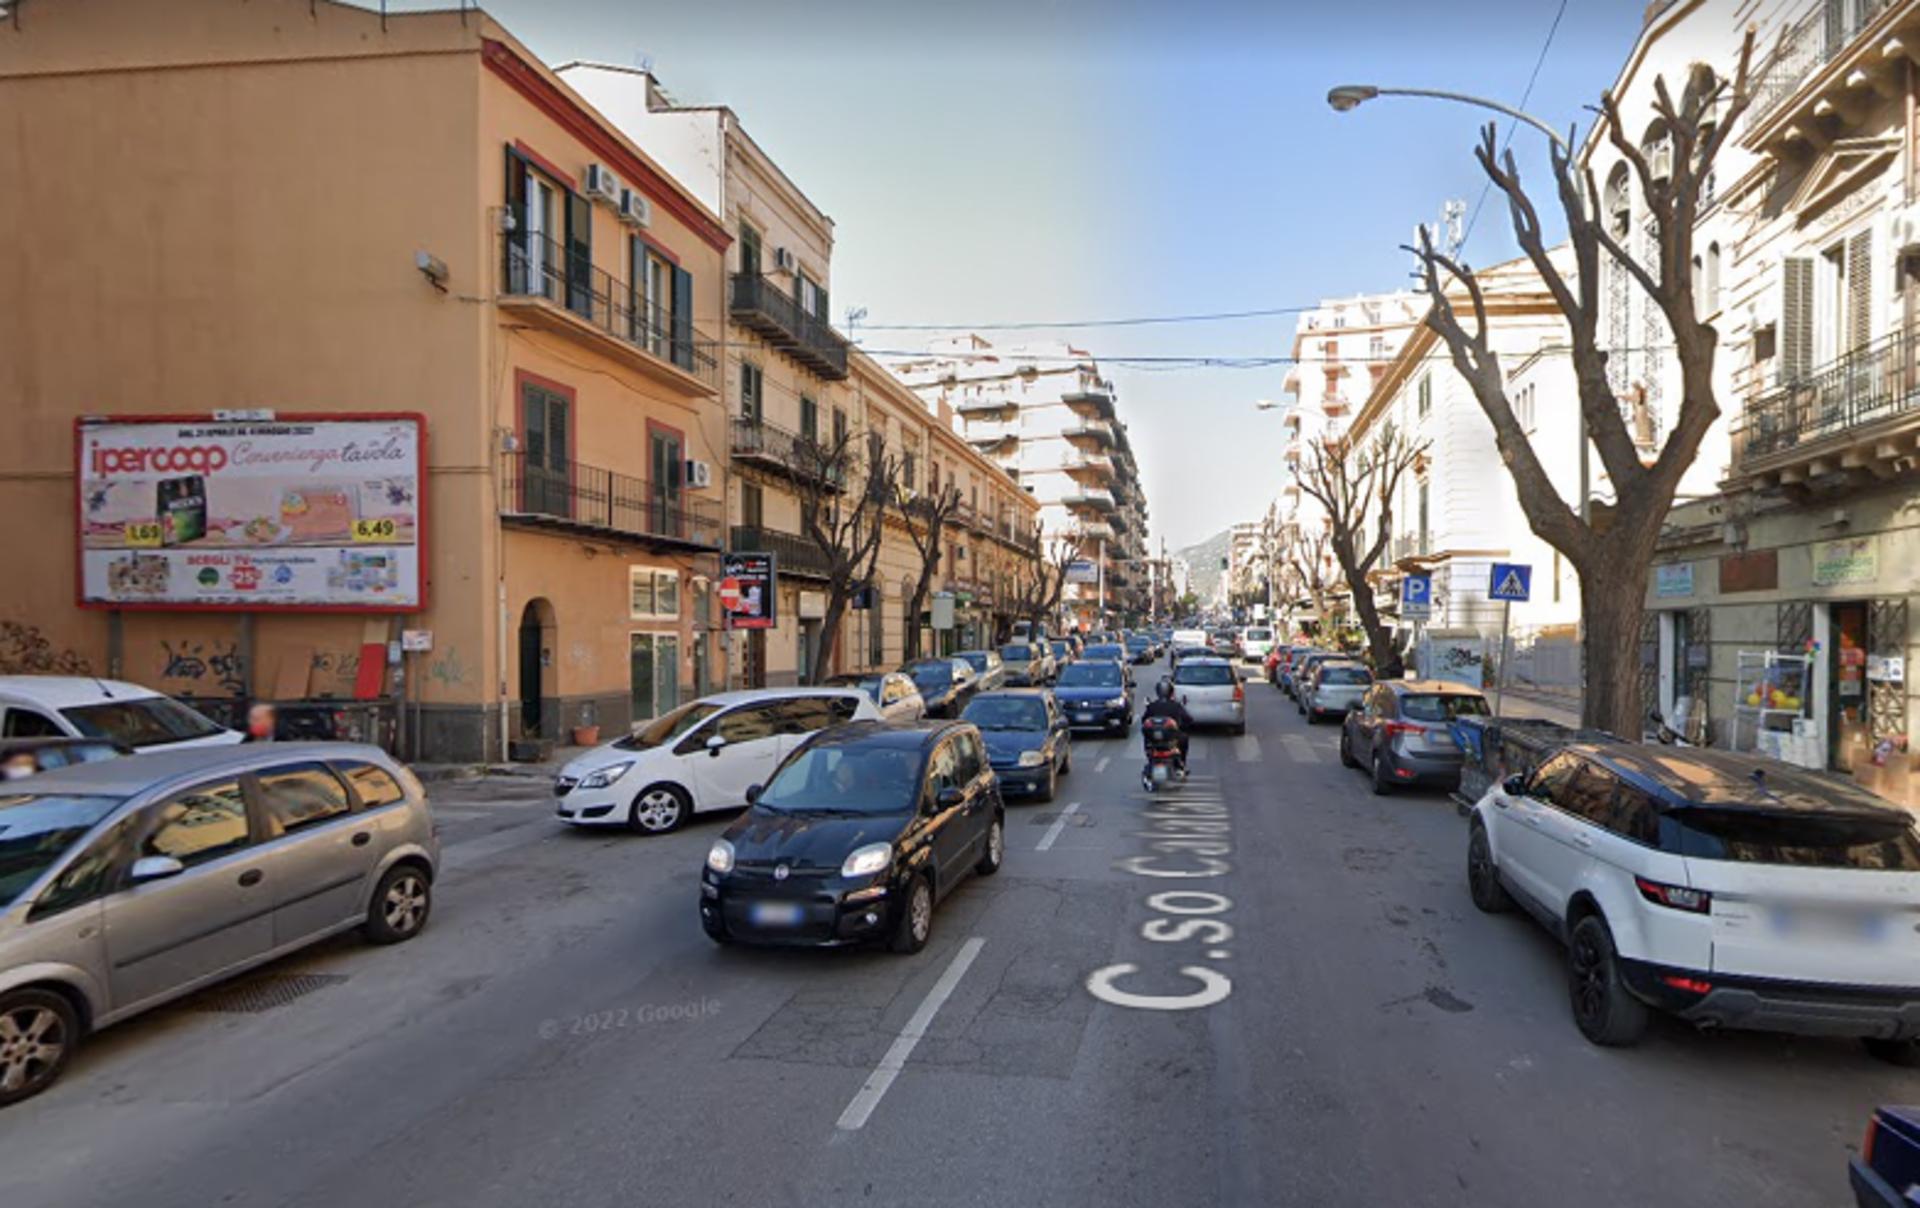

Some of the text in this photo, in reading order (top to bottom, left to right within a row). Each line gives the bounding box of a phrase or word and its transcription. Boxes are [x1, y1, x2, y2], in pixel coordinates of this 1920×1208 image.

[91, 440, 228, 478] ipercoop
[130, 525, 159, 541] 1,69
[357, 520, 393, 537] 6,49
[1409, 579, 1425, 600] P
